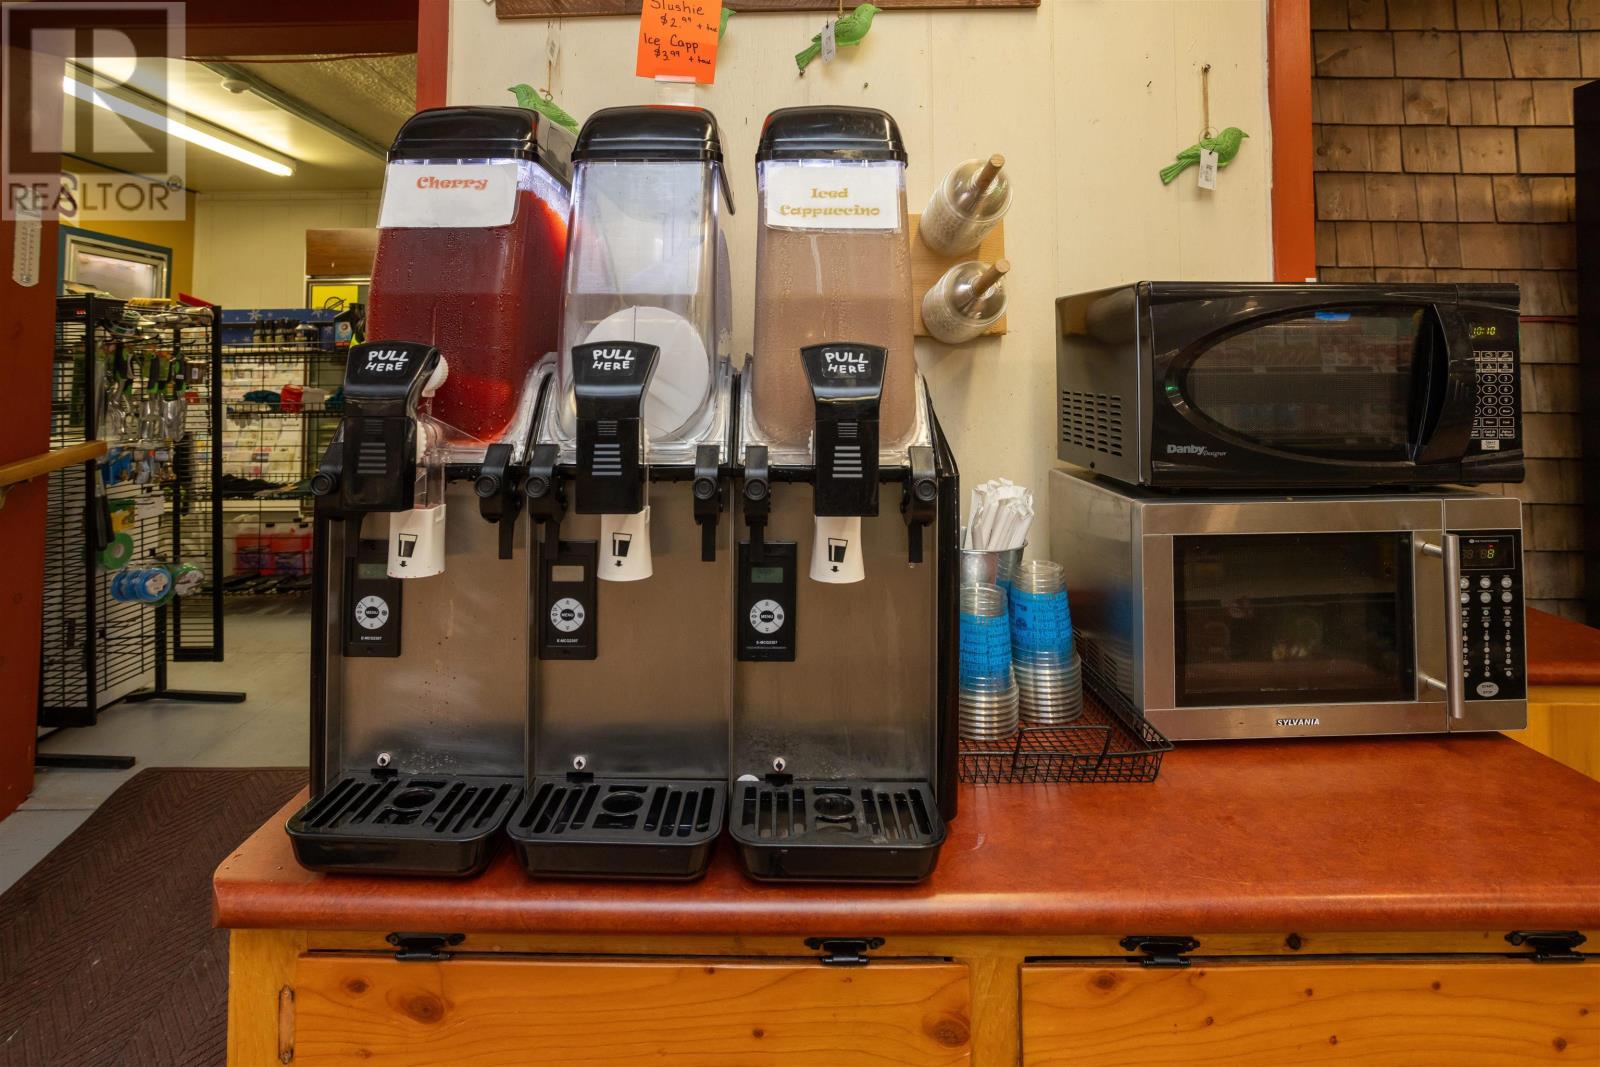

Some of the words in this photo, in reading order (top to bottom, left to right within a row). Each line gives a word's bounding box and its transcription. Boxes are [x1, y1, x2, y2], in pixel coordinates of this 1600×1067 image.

[650, 0, 704, 15] Slushie
[643, 32, 661, 46] Ice
[670, 33, 699, 54] Capp
[416, 175, 489, 191] Cherry
[810, 186, 849, 199] Iced
[780, 203, 881, 218] Cappuccino
[368, 350, 409, 362] PULL
[592, 348, 635, 361] PULL
[824, 351, 869, 364] PULL
[365, 361, 404, 372] HERE
[592, 360, 631, 371] HERE
[827, 363, 866, 374] HERE
[1166, 444, 1204, 456] Danby
[1276, 718, 1320, 727] SYLVANIA
